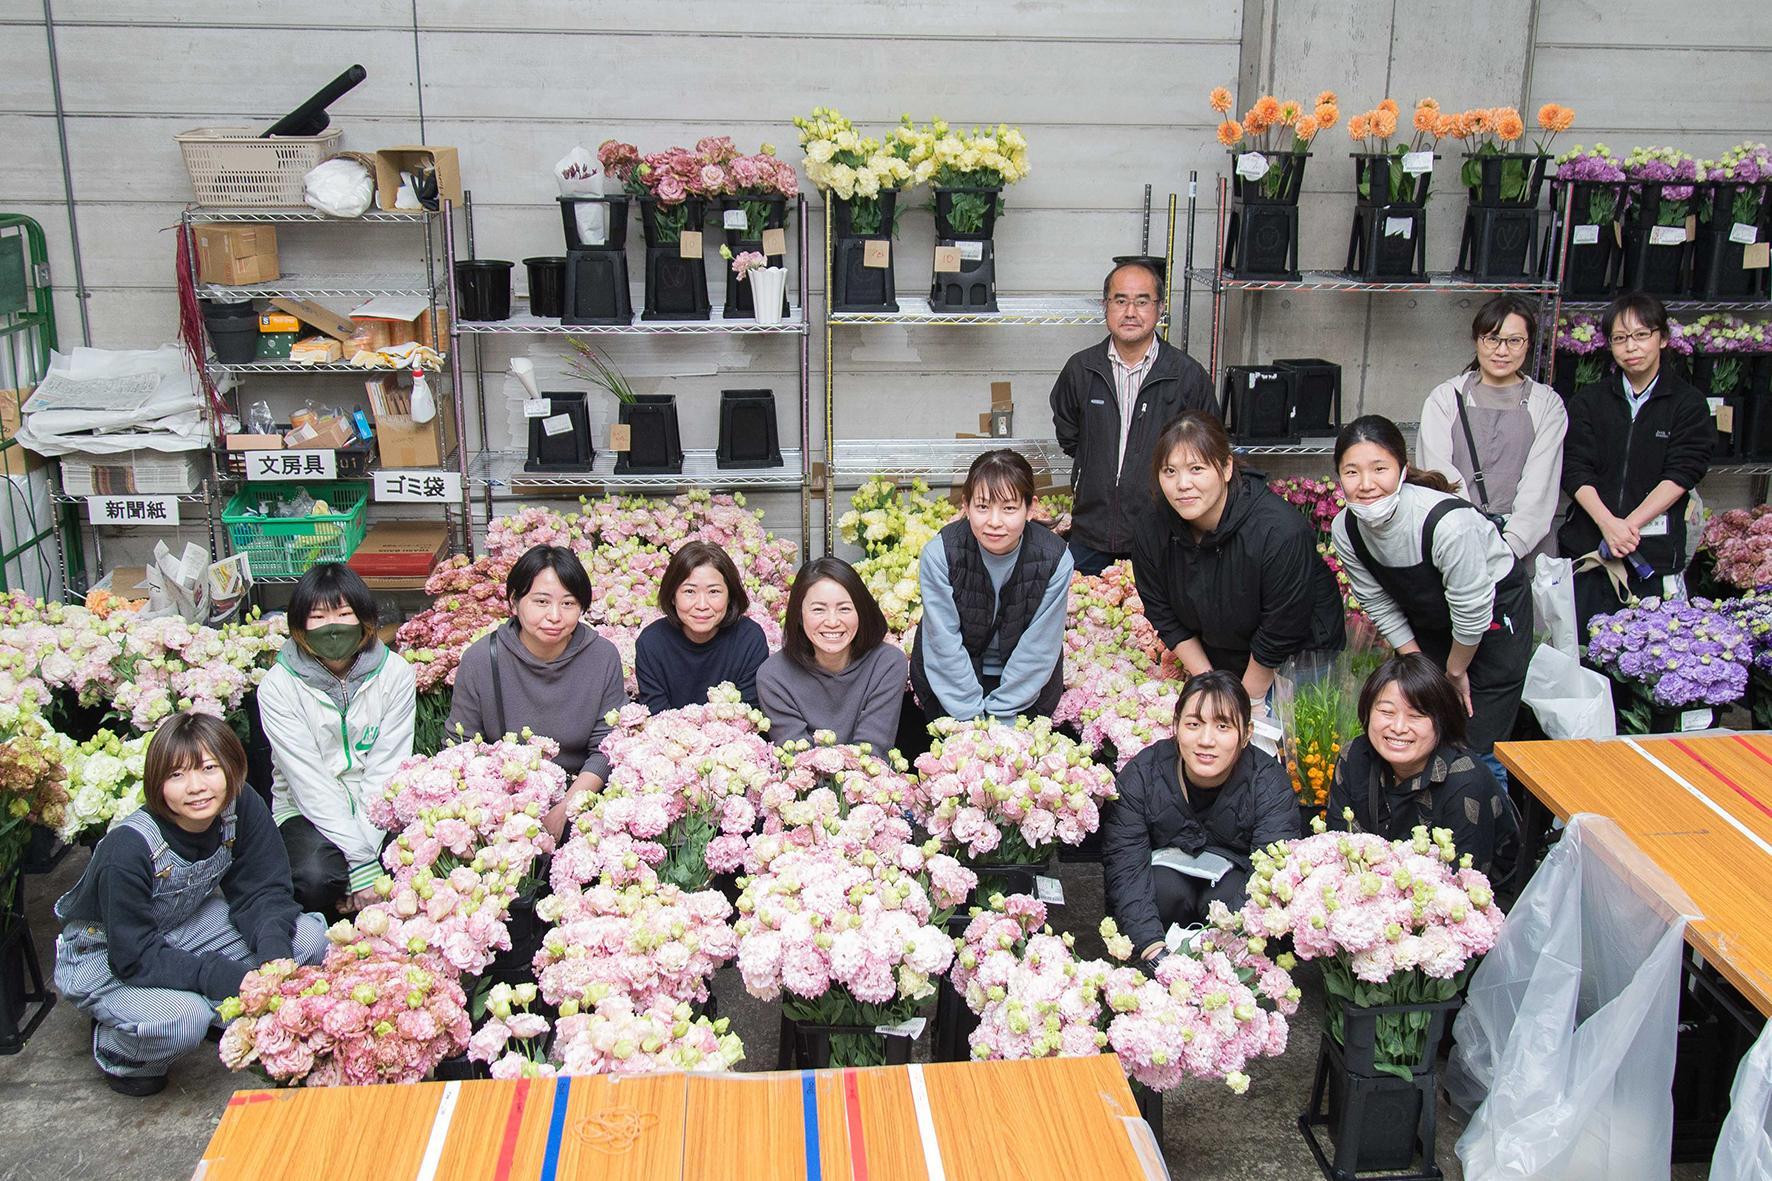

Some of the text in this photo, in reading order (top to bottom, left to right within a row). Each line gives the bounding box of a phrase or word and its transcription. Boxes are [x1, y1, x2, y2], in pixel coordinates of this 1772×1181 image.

[258, 455, 325, 475] 文房具
[385, 476, 446, 498] ゴミ袋
[105, 500, 167, 520] 新聞紙
